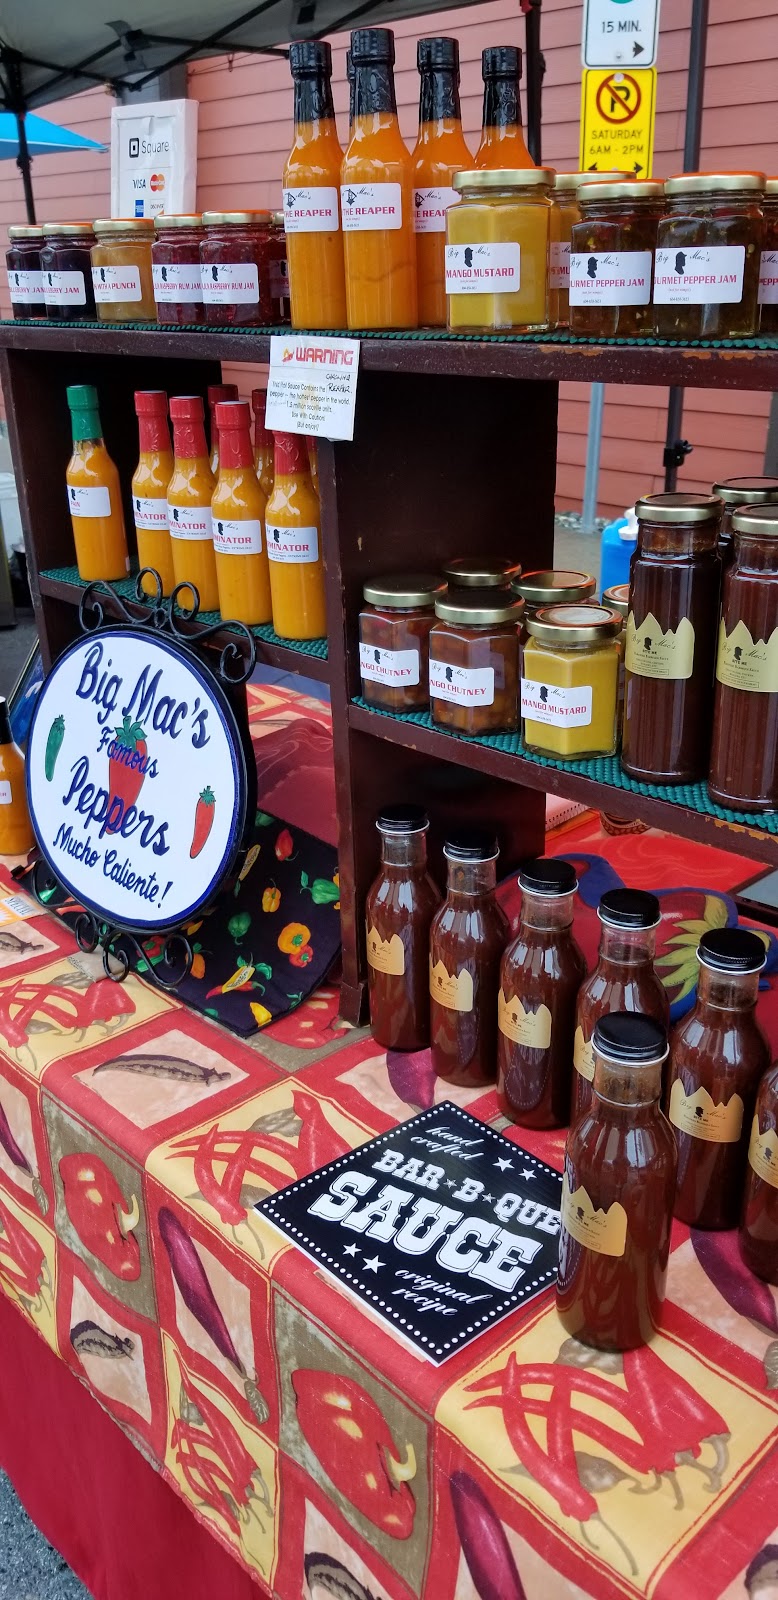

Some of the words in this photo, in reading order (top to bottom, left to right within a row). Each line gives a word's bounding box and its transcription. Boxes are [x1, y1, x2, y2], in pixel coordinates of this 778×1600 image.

[602, 21, 614, 34] 15
[618, 20, 642, 32] MIN.
[592, 129, 643, 140] SATURDAY
[142, 140, 170, 156] Square
[590, 145, 611, 155] 6AM
[622, 144, 644, 155] 2PM
[132, 179, 146, 189] VISA
[294, 209, 332, 217] REAPER
[343, 208, 354, 216] THE
[356, 206, 395, 215] REAPER
[446, 268, 472, 279] MANGO
[474, 267, 514, 278] MUSTARD
[683, 275, 716, 284] PEPPER
[718, 274, 736, 283] JAM
[112, 282, 136, 290] PUNCH
[178, 282, 190, 290] RUM
[232, 282, 242, 290] RUM
[244, 282, 254, 290] JAM
[596, 278, 626, 287] PEPPER
[626, 278, 644, 286] JAM
[296, 346, 354, 366] WARNING
[288, 382, 300, 390] Sauce
[310, 394, 326, 402] pepper
[330, 396, 338, 404] the
[376, 665, 412, 676] CHUTNEY
[76, 641, 124, 724] Big
[122, 663, 211, 749] Mac's
[448, 682, 486, 696] CHUTNEY
[522, 698, 546, 711] MANGO
[548, 704, 587, 716] MUSTARD
[97, 726, 159, 778] Famous
[63, 756, 170, 856] Peppers
[53, 822, 100, 868] Mucho
[103, 848, 174, 909] Caliente!
[426, 1126, 484, 1148] hand
[410, 1136, 484, 1161] crafted
[372, 1149, 446, 1190] BAR
[452, 1177, 486, 1202] B
[307, 1171, 544, 1292] SAUCE
[395, 1269, 494, 1305] original
[392, 1288, 458, 1316] recipe
